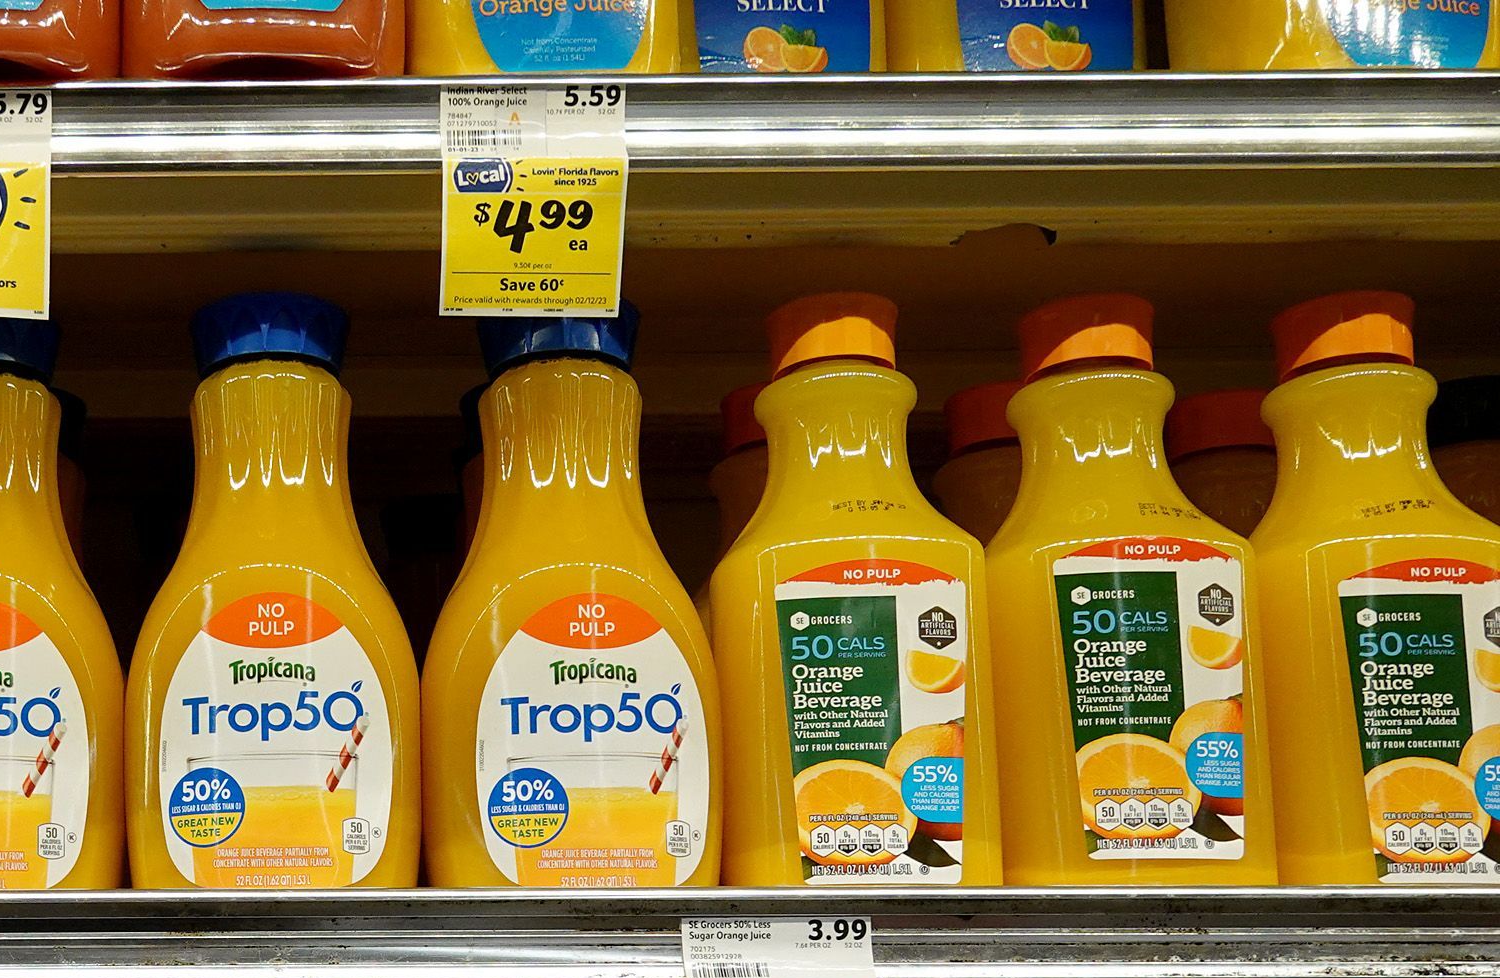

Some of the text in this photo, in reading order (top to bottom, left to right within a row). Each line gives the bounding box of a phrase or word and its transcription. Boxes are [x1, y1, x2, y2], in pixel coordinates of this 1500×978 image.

[473, 98, 504, 107] Orange
[506, 98, 527, 106] Juice
[564, 85, 621, 107] 5.59
[569, 240, 587, 250] ea
[500, 279, 535, 291] Save
[454, 296, 473, 304] Price
[475, 296, 492, 304] valid
[544, 297, 573, 305] through
[575, 296, 606, 305] 02/12/23
[843, 569, 900, 579] NO PULP
[1411, 568, 1466, 577] NO PULP
[258, 603, 284, 618] NO
[578, 604, 605, 618] NO
[811, 615, 852, 625] GROCERS
[249, 621, 294, 636] PULP
[569, 622, 614, 636] PULP
[791, 635, 885, 660] 50 CALS
[229, 657, 316, 684] Tropicana
[792, 665, 863, 680] Orange
[793, 680, 843, 694] Juice
[793, 695, 881, 710] Beverage
[182, 691, 363, 741] Trop50
[501, 692, 682, 742] Trop50
[819, 711, 847, 719] Other
[850, 710, 888, 719] Natural
[795, 721, 829, 729] Flavors
[853, 719, 885, 728] Added
[795, 730, 840, 739] Vitamins
[836, 742, 887, 750] CONCENTRATE
[912, 766, 957, 782] 55%
[182, 779, 230, 802] 50%
[177, 817, 235, 828] GREAT NEW
[191, 828, 220, 838] TASTE
[689, 932, 771, 941] Sugar Orange Juice
[701, 921, 732, 929] Grocers
[808, 919, 867, 941] 3.99
